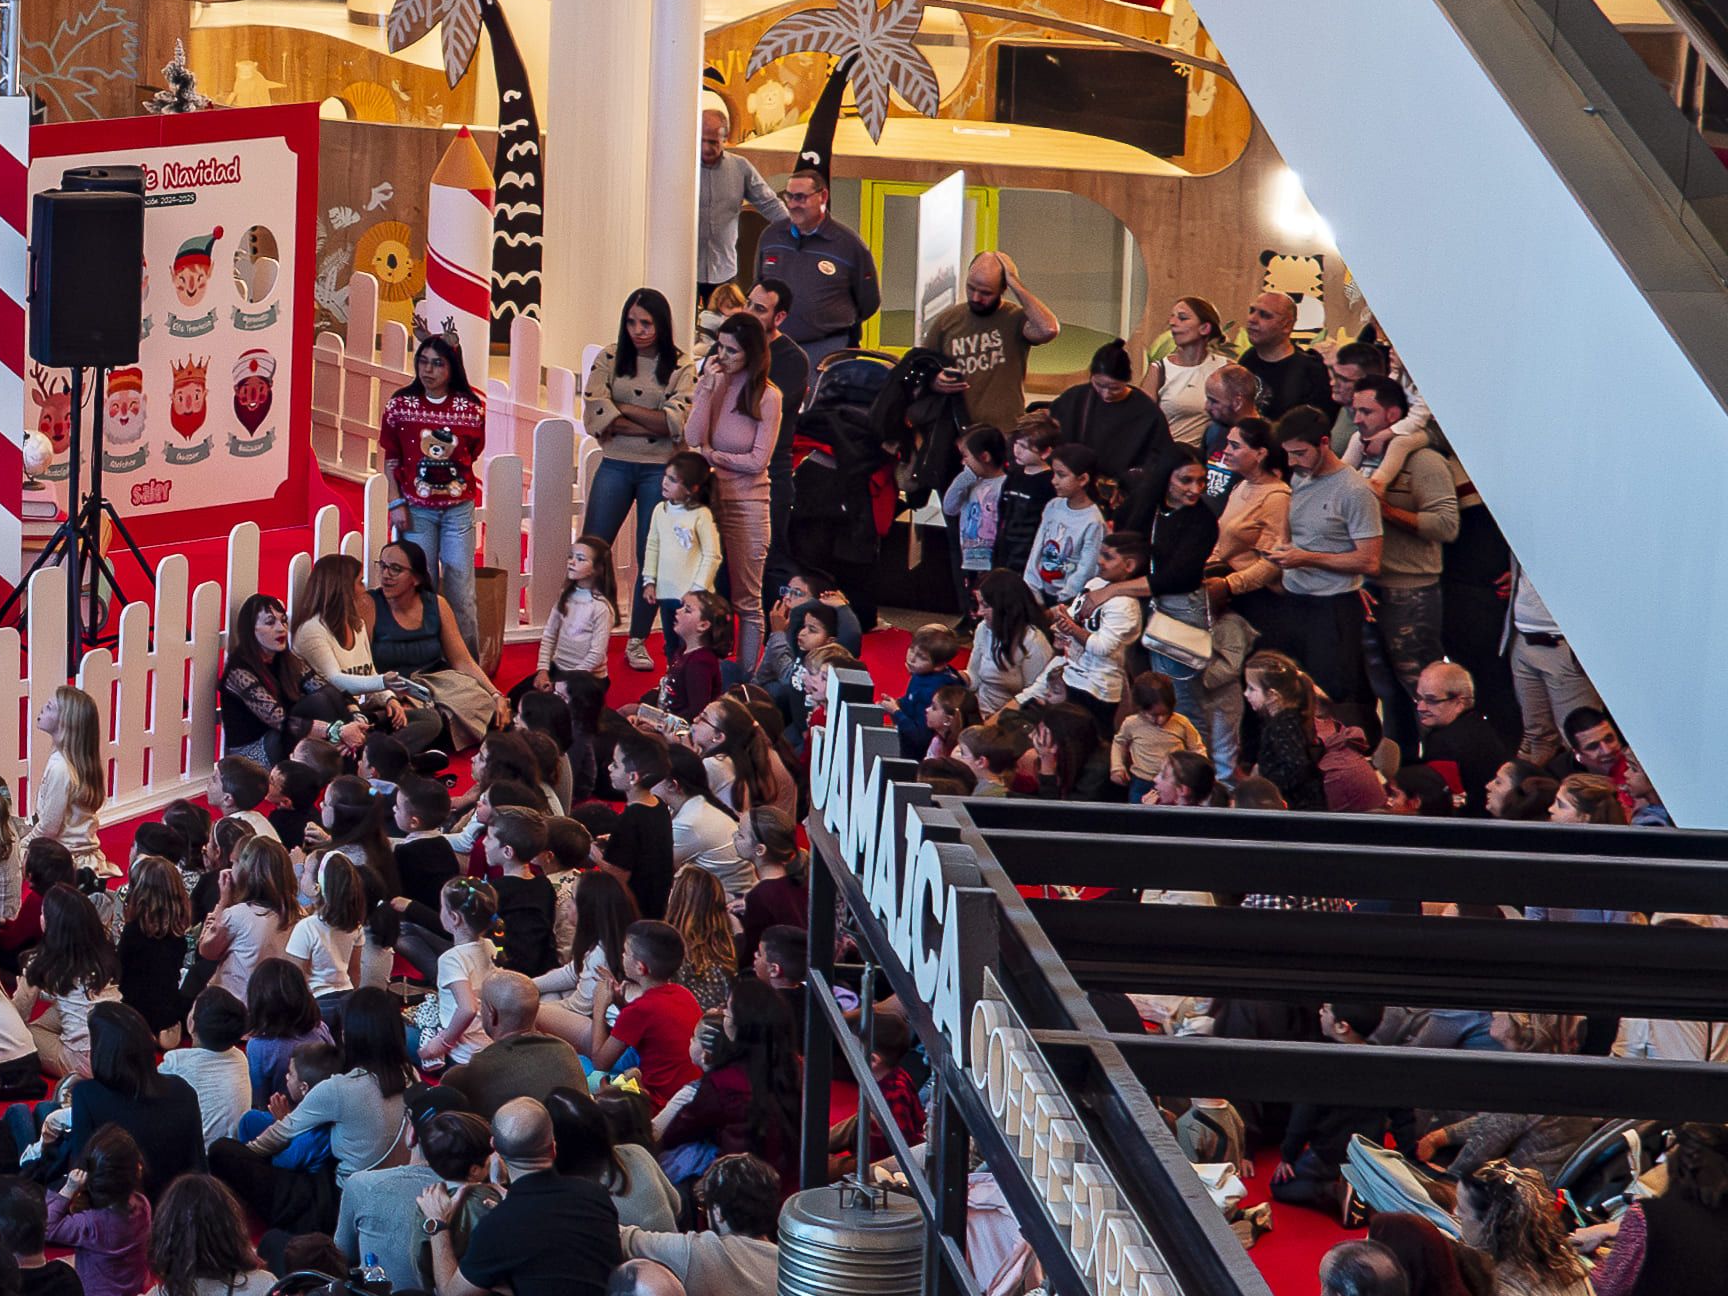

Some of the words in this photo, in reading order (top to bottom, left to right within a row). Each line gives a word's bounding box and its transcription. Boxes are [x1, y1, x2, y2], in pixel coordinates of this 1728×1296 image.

[164, 155, 241, 189] Navidad
[952, 330, 1003, 357] NYAS
[810, 665, 962, 1070] JAMAICA
[971, 999, 1080, 1226] COFFEE
